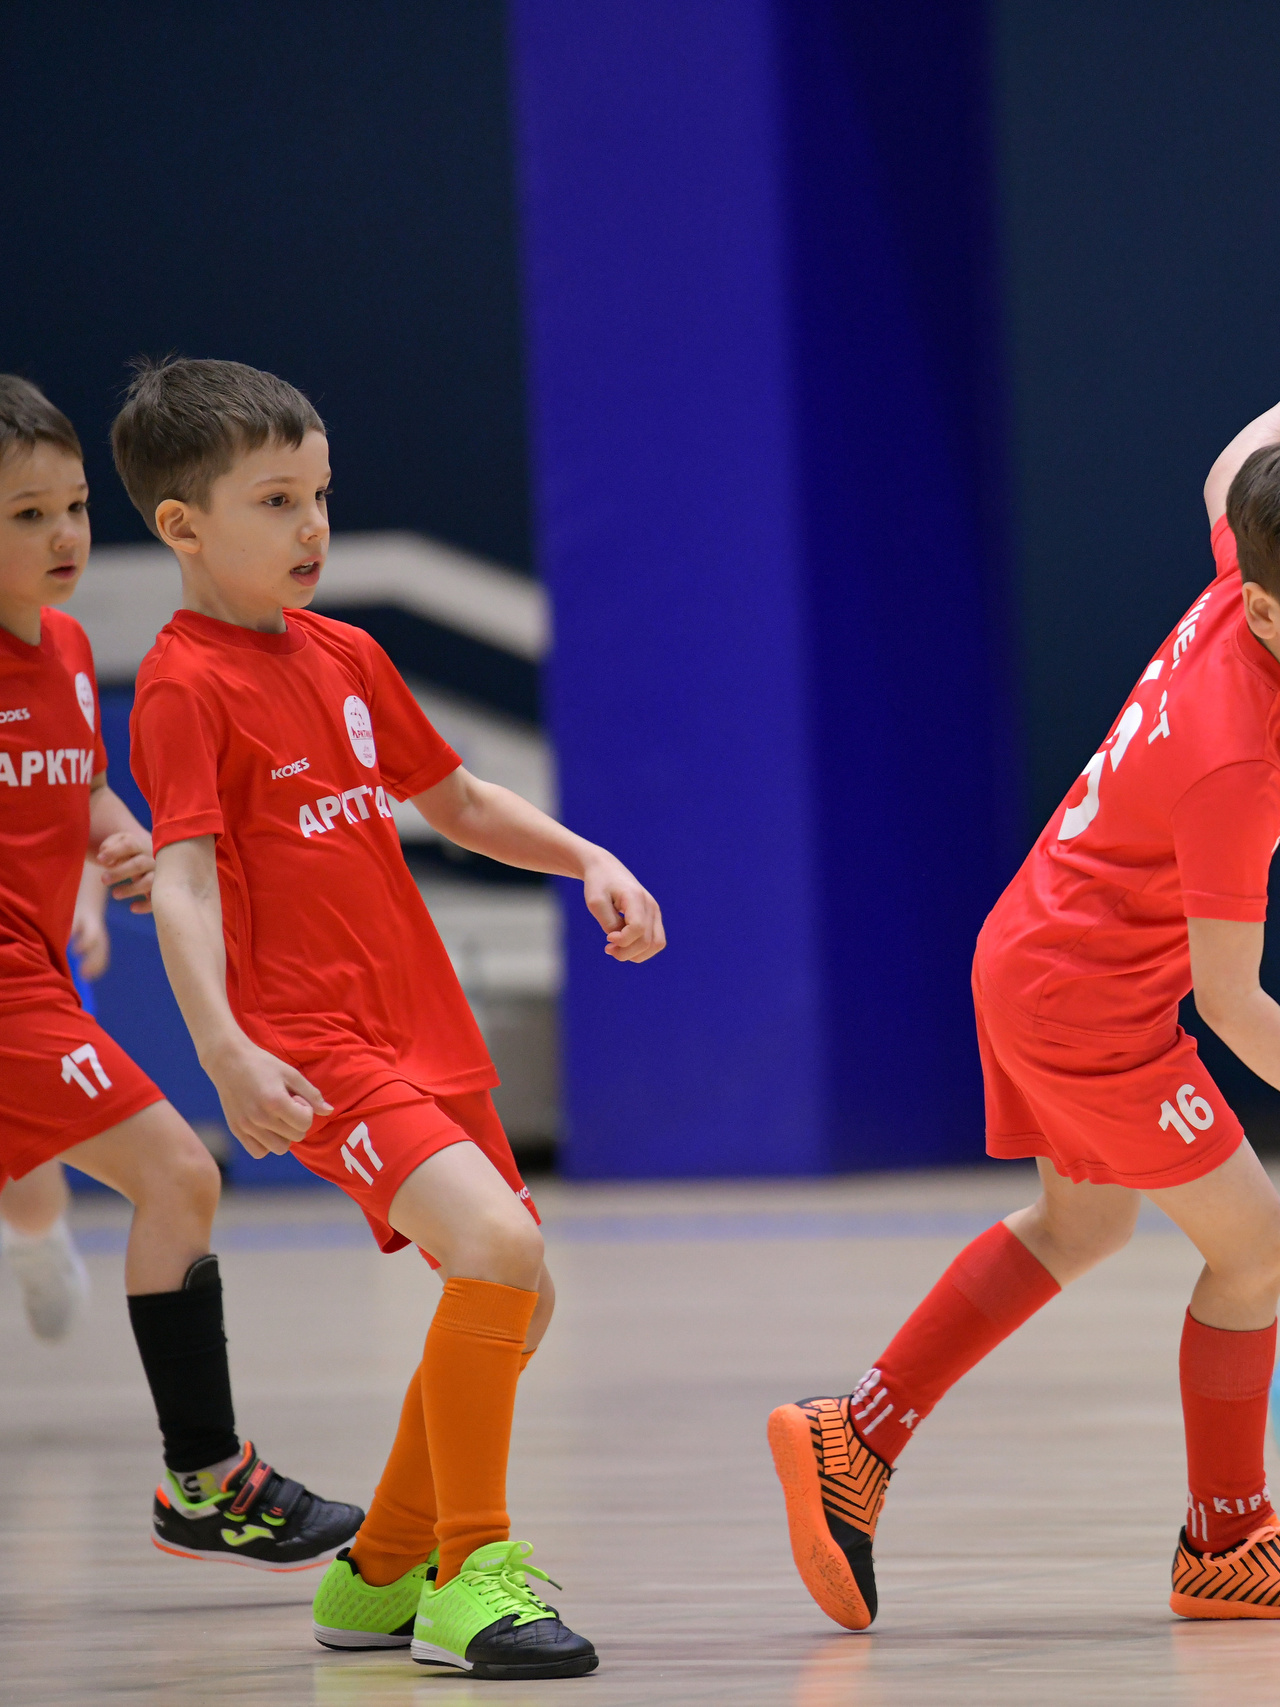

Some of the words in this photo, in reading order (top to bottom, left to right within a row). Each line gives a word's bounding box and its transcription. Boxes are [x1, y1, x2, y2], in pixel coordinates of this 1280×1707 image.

[61, 1042, 112, 1099] 17
[1158, 1083, 1215, 1145] 16
[340, 1121, 384, 1186] 17
[810, 1398, 852, 1476] PUMA
